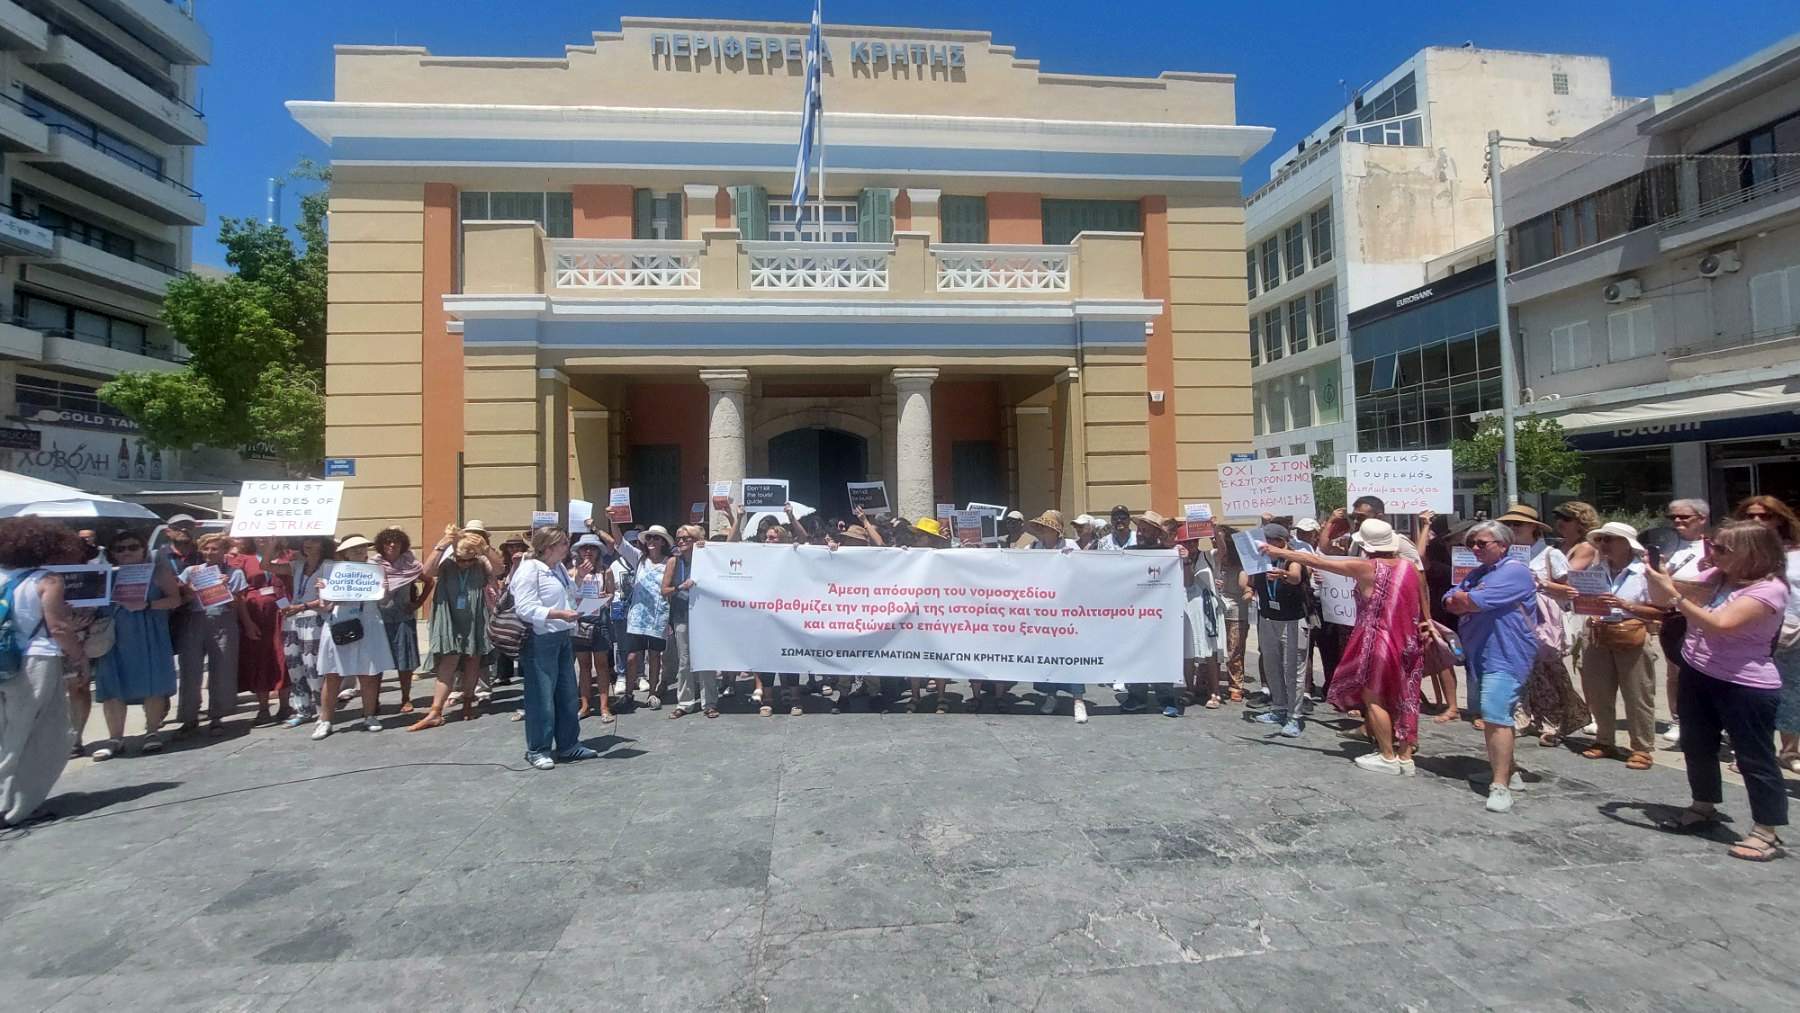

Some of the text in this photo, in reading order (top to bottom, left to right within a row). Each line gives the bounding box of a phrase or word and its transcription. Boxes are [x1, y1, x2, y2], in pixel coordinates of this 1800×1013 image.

[651, 32, 965, 67] ΠΕΡΙΦΕΡΕΑ ΚΡΗΤΗΣ
[1396, 289, 1432, 307] EUROBANK
[60, 411, 104, 424] GOLD
[1223, 460, 1309, 476] ΟΧΙ ΣΤΟΝ
[247, 483, 323, 491] TOURIST
[249, 497, 309, 505] GUIDES
[237, 521, 322, 531] ON STRIKE
[335, 571, 373, 579] Qualified
[828, 583, 1056, 600] Άμεση απόσυρση του νομοσχεδίου
[721, 599, 1163, 619] που υποβαθμίζει την προβολή της ιστορίας και του πολιτισμού μας
[804, 618, 1078, 637] και απαξιώνει το επάγγελμα του ξεναγού.
[781, 648, 1104, 665] ΣΩΜΑΤΕΙΟ ΕΠΑΓΓΕΛΜΑΤΙΩΝ ΞΕΝΑΓΩΝ ΚΡΗΤΗΣ ΚΑΙ ΣΑΝΤΟΡΙΝΗΣ
